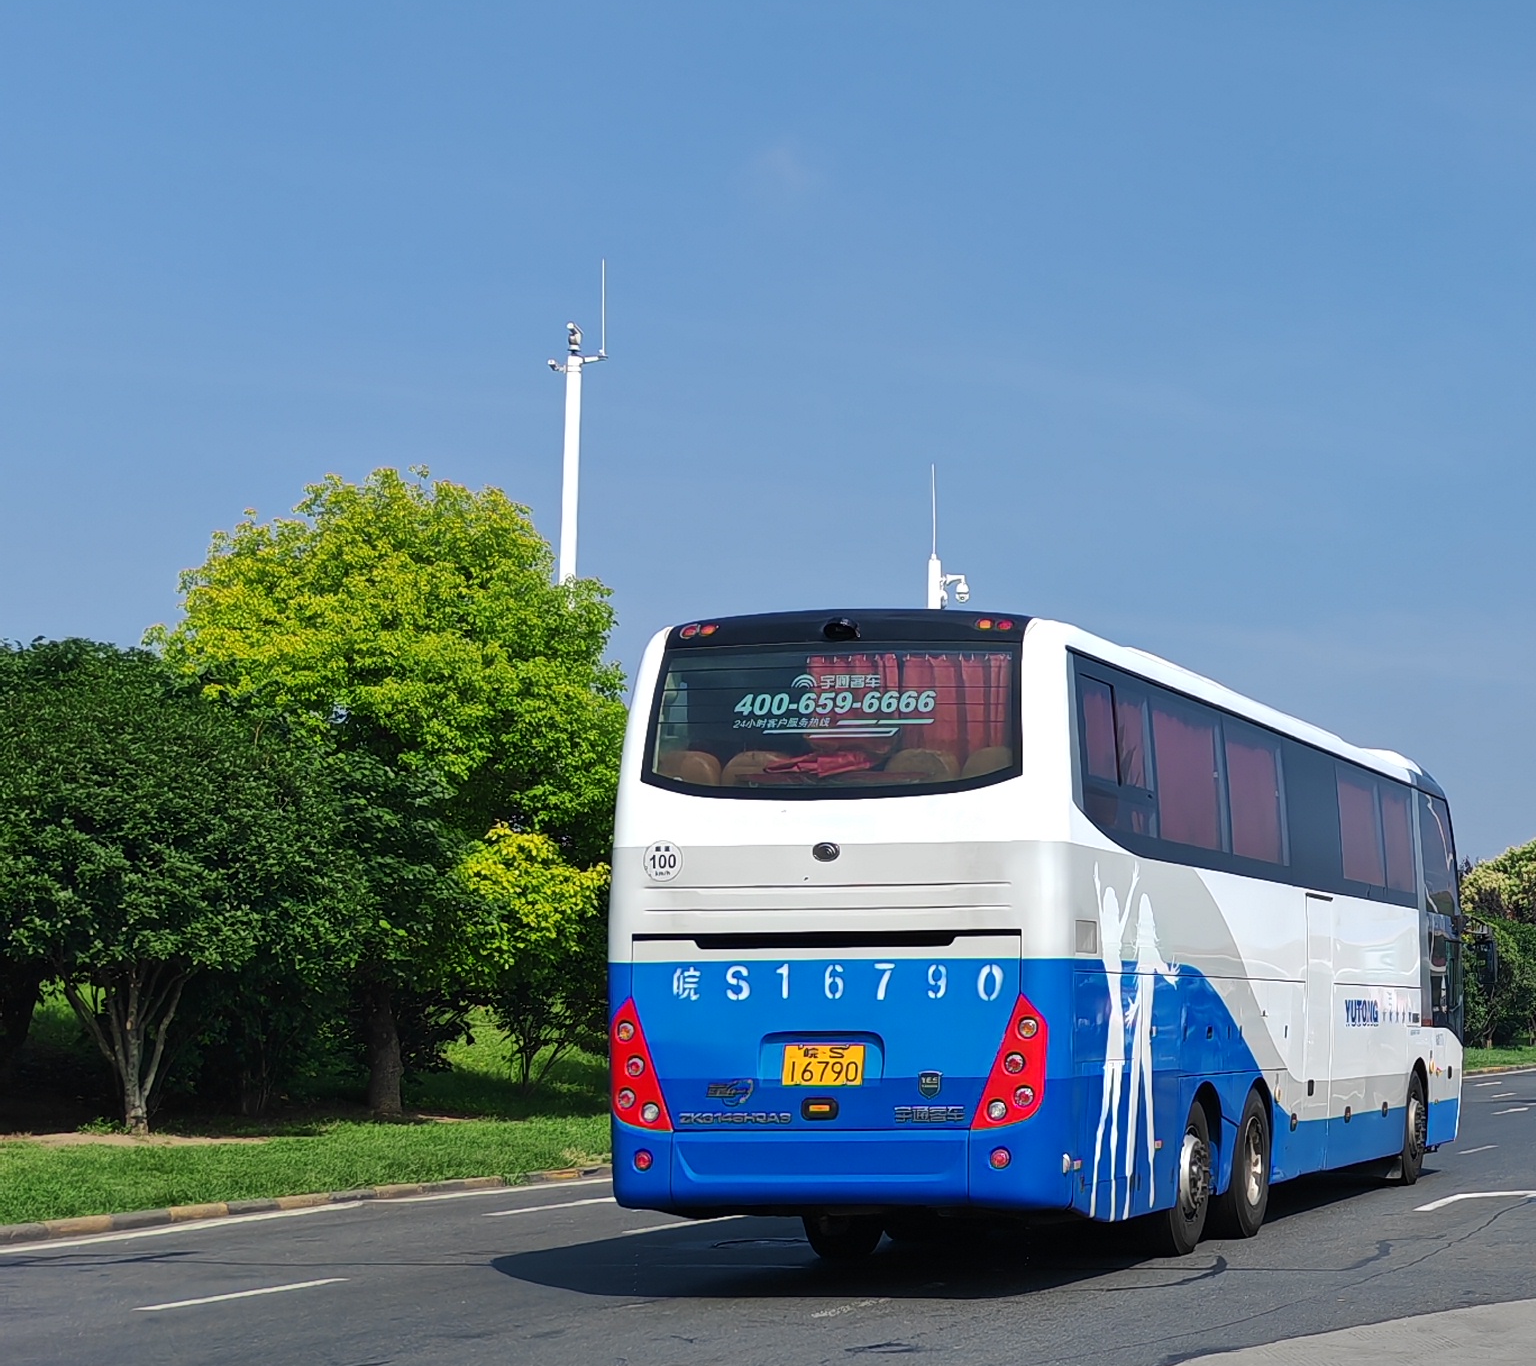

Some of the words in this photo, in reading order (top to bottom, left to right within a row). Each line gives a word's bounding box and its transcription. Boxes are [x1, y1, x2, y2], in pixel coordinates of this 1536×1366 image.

[820, 675, 881, 689] 宇通客车
[734, 691, 936, 716] 400-659-6666
[732, 718, 830, 729] 24小时客户服务热线
[650, 854, 676, 869] 100
[1345, 1000, 1378, 1023] YUTONG
[790, 1061, 859, 1083] 16790
[894, 1106, 965, 1123] 宇通客车
